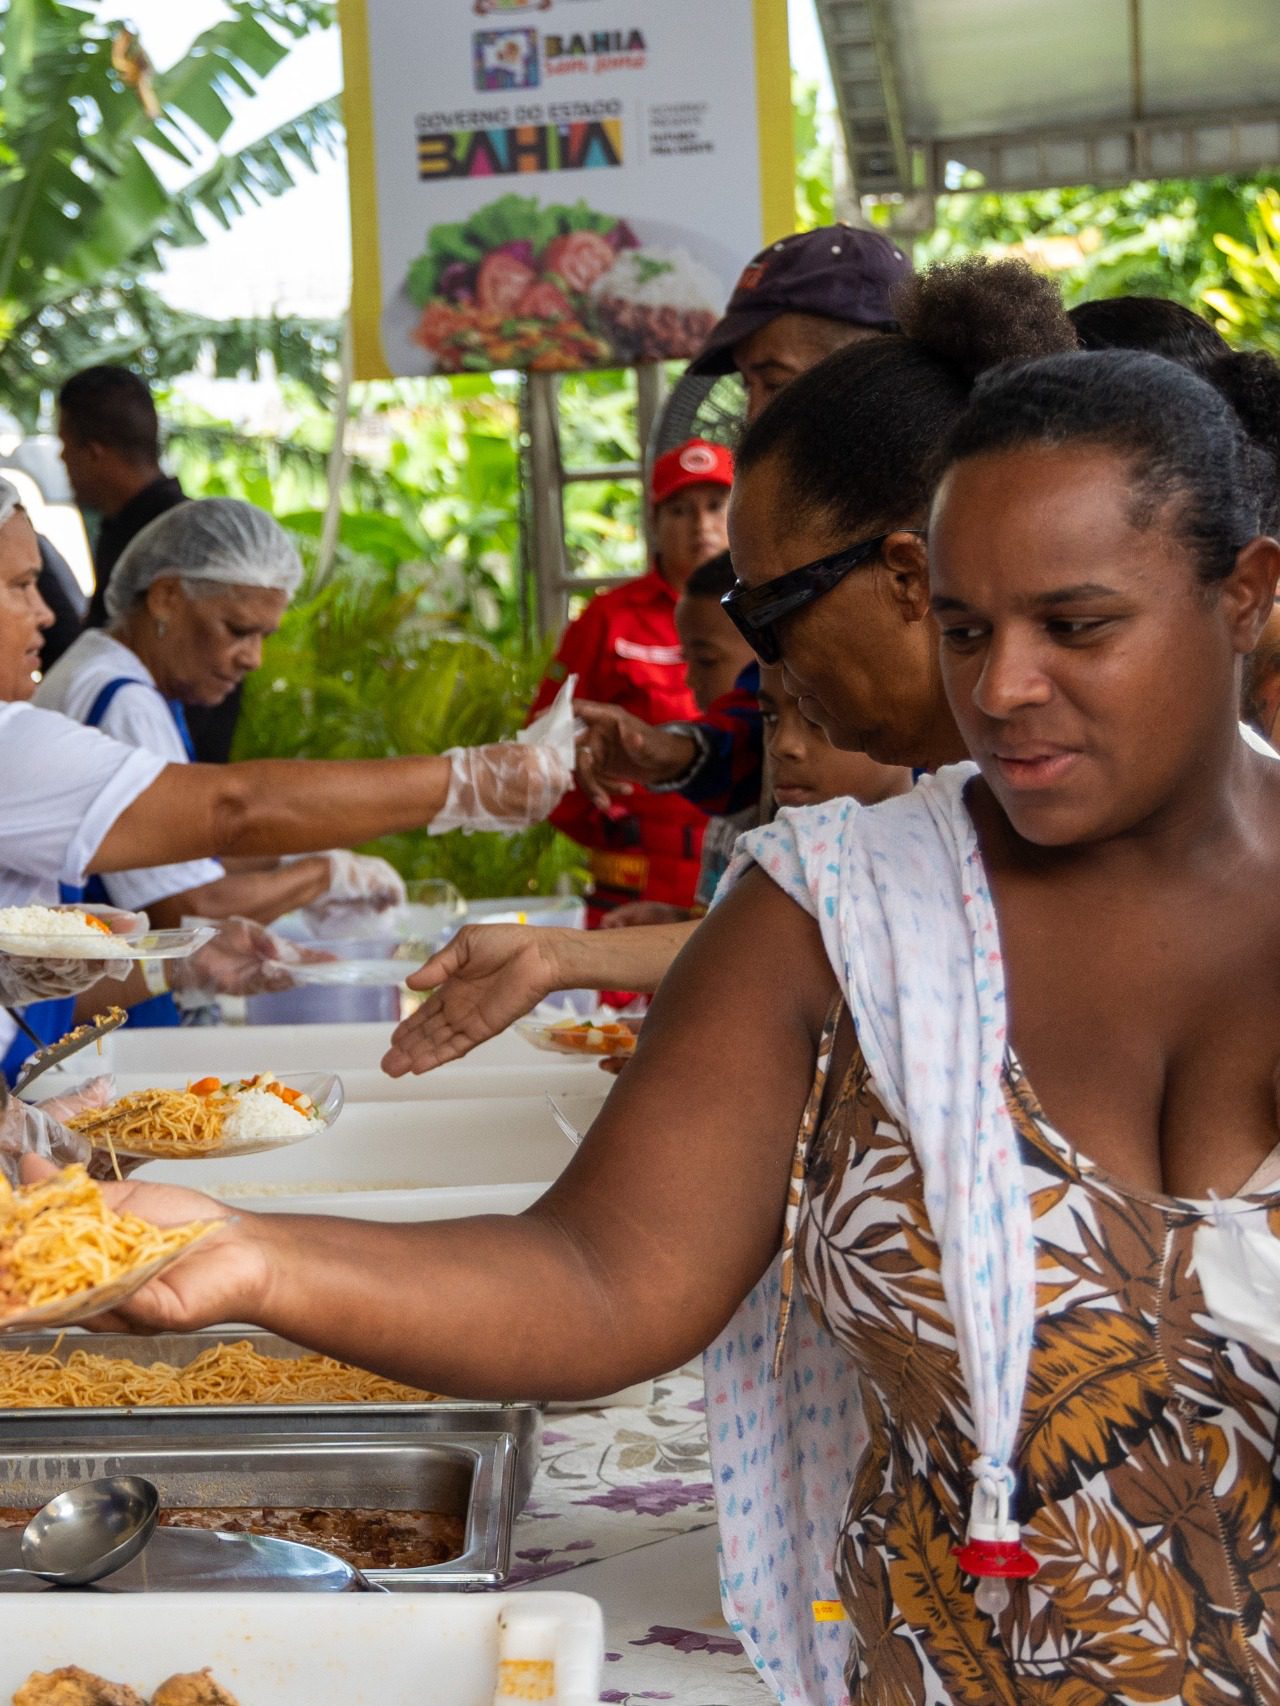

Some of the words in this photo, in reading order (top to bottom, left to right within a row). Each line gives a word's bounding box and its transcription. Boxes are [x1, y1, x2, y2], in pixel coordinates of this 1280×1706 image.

[544, 29, 646, 57] BAHIA
[415, 106, 510, 131] GOVERNO
[515, 102, 543, 121] DO
[546, 98, 623, 120] ESTADO
[417, 116, 623, 182] BAHIA
